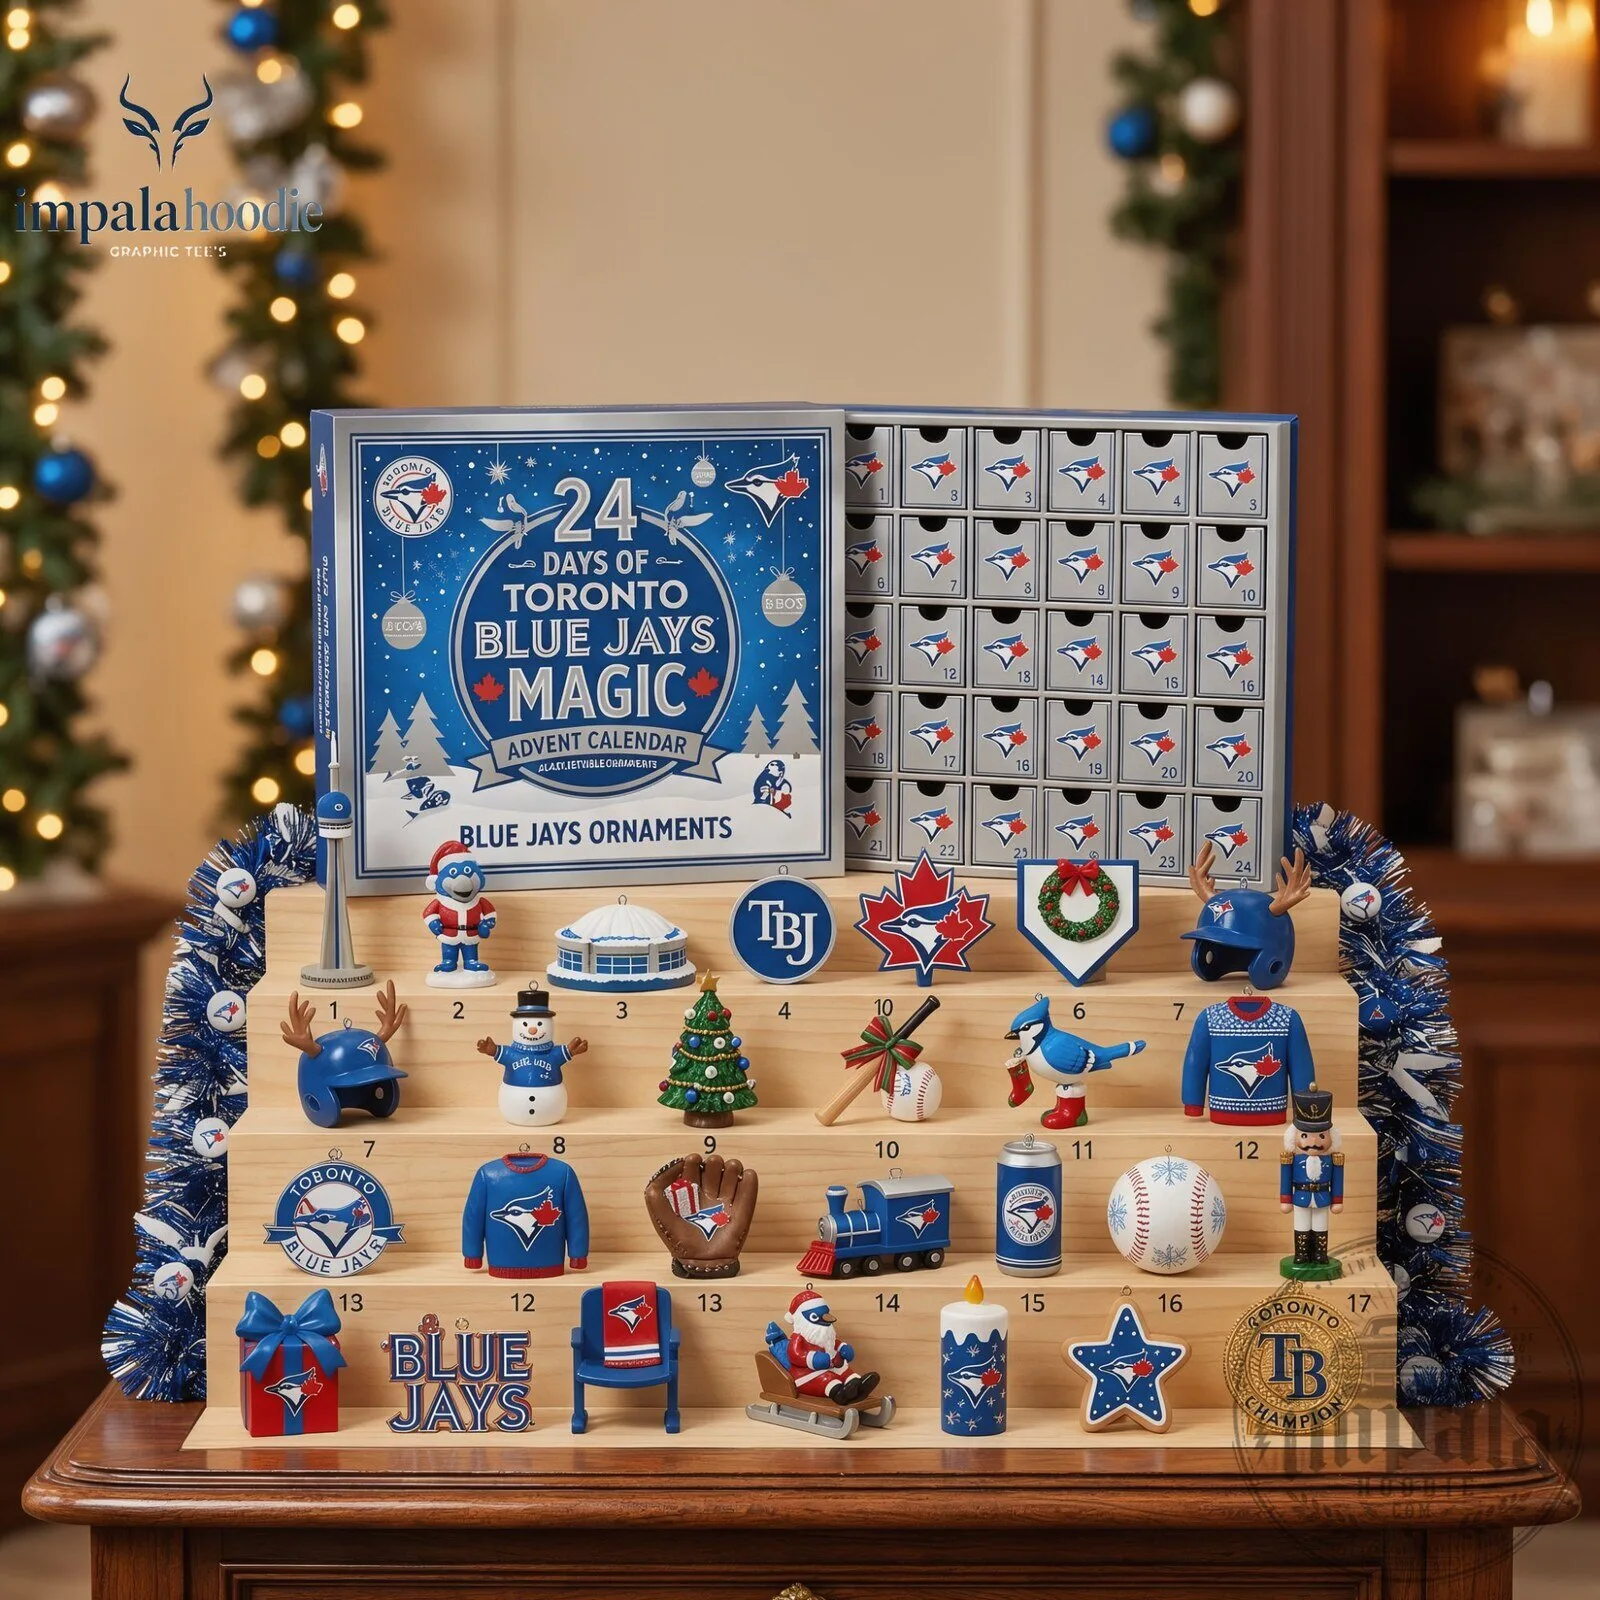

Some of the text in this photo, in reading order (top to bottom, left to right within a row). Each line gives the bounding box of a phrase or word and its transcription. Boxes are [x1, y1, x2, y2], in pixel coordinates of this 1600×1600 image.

[1024, 491, 1033, 504] 3
[1097, 492, 1107, 507] 4
[1172, 495, 1182, 508] 4
[553, 477, 637, 543] 24
[543, 549, 649, 576] DAYS OF
[877, 576, 885, 589] 6
[949, 579, 958, 592] 7
[1024, 581, 1032, 594] 8
[1171, 586, 1180, 599] 9
[503, 579, 688, 612] TORONTO
[1240, 589, 1256, 602] 10
[474, 615, 716, 659] BLUE JAYS
[872, 665, 884, 678] 11
[943, 667, 958, 680] 12
[508, 662, 688, 722] MAGIC
[1240, 679, 1255, 693] 16
[508, 731, 687, 760] ADVENT CALENDAR
[871, 752, 885, 765] 18
[943, 754, 956, 768] 17
[1015, 758, 1031, 772] 16
[1160, 766, 1178, 779] 20
[1236, 770, 1255, 783] 20
[459, 816, 733, 848] BLUE JAYS ORNAMENTS
[869, 839, 884, 852] 21
[939, 844, 956, 857] 22
[1158, 855, 1176, 869] 23
[1234, 860, 1252, 873] 24
[748, 899, 818, 966] TBJ
[328, 1000, 338, 1020] 1
[452, 1000, 466, 1020] 2
[615, 1000, 628, 1020] 3
[777, 1000, 792, 1020] 4
[874, 998, 894, 1018] 10
[1072, 1001, 1087, 1020] 6
[1172, 1002, 1185, 1021] 7
[362, 1140, 377, 1160] 7
[553, 1136, 566, 1154] 8
[703, 1135, 717, 1155] 9
[874, 1140, 900, 1160] 10
[1071, 1140, 1093, 1160] 11
[1234, 1140, 1260, 1160] 12
[338, 1293, 364, 1313] 13
[510, 1292, 536, 1312] 12
[697, 1292, 723, 1313] 13
[875, 1293, 901, 1313] 14
[1020, 1293, 1045, 1313] 15
[1157, 1293, 1184, 1313] 16
[1346, 1293, 1372, 1313] 17
[389, 1330, 533, 1383] BLUE
[1258, 1332, 1328, 1400] TB
[386, 1382, 533, 1433] JAYS
[1244, 1394, 1345, 1429] CHAMPION
